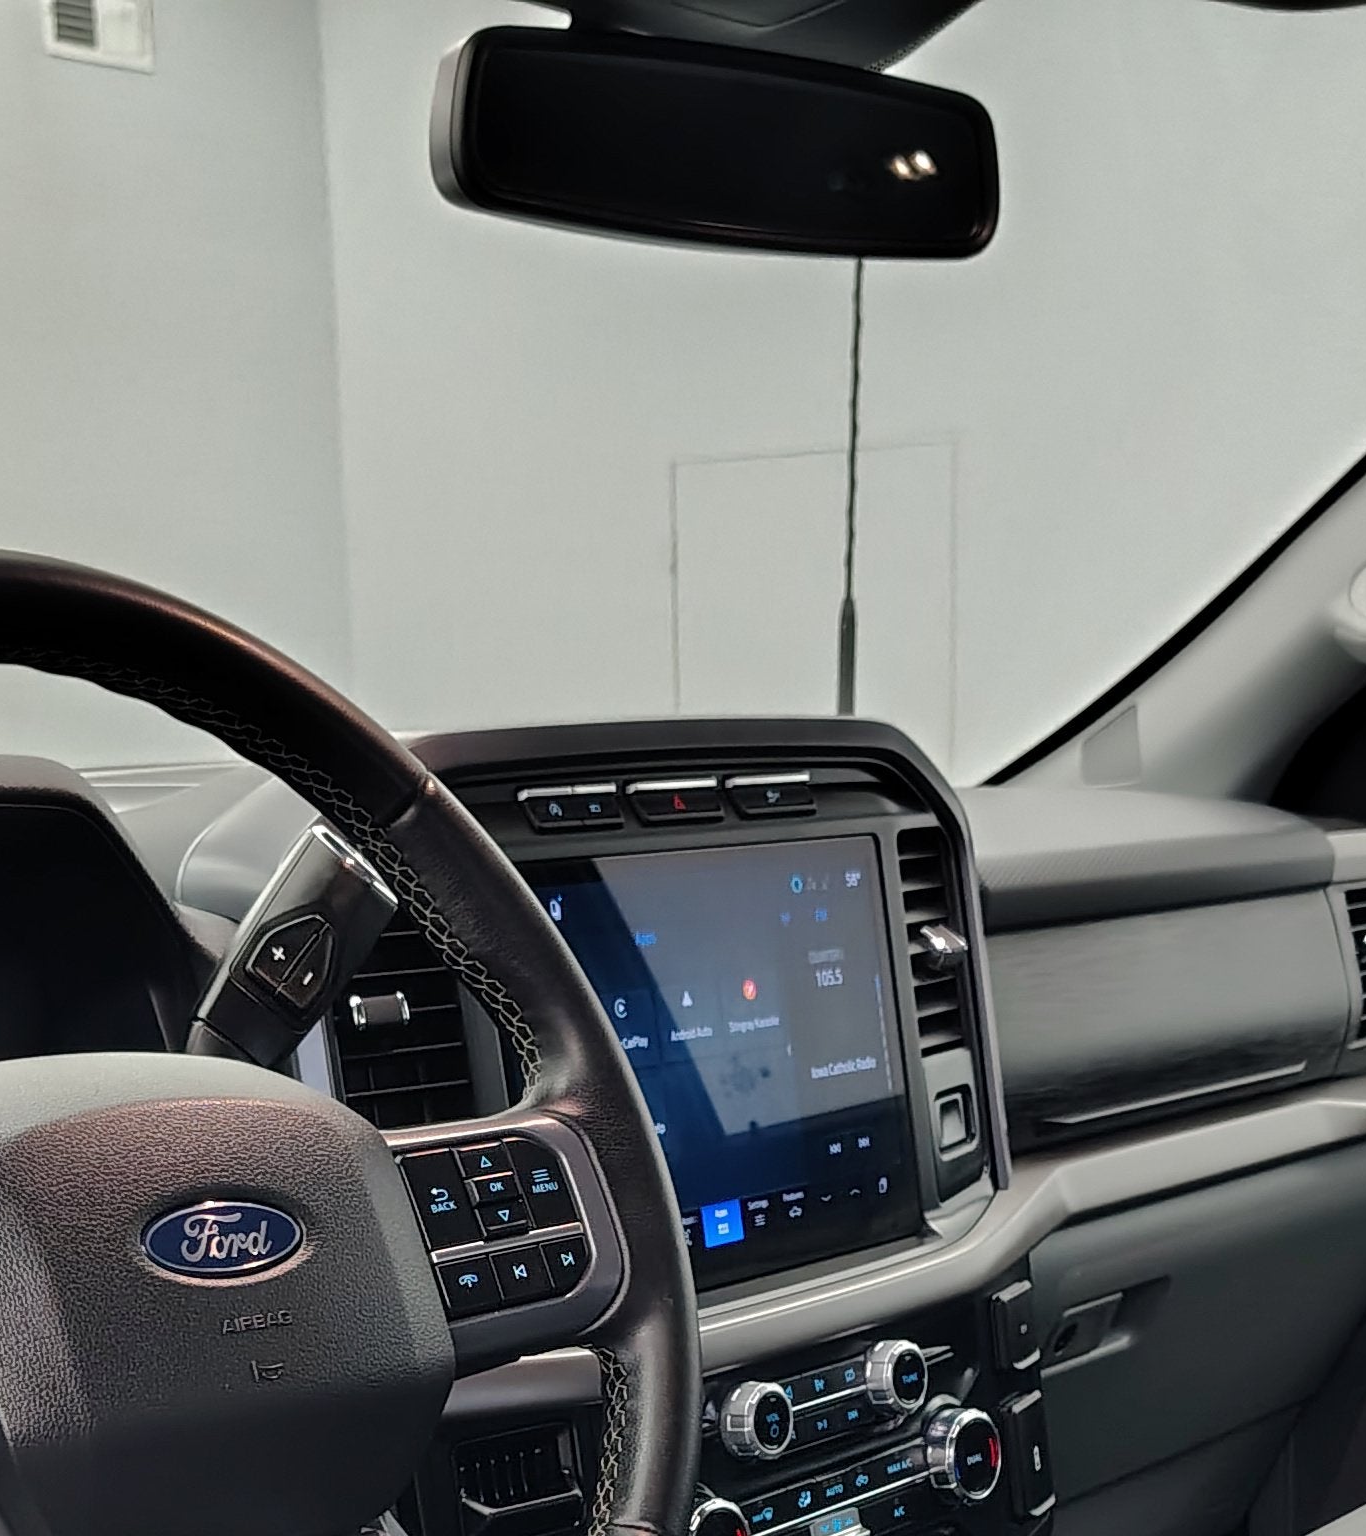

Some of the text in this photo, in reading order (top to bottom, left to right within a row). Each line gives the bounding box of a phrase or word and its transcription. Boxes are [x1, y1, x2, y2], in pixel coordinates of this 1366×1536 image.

[488, 1180, 505, 1193] OK
[531, 1180, 560, 1195] MENU
[430, 1198, 458, 1215] BACK
[181, 1212, 273, 1263] Ford
[221, 1310, 294, 1336] AIRBAG
[966, 1453, 983, 1467] DUAL
[825, 1484, 844, 1498] AUTO
[893, 1505, 906, 1518] A/C
